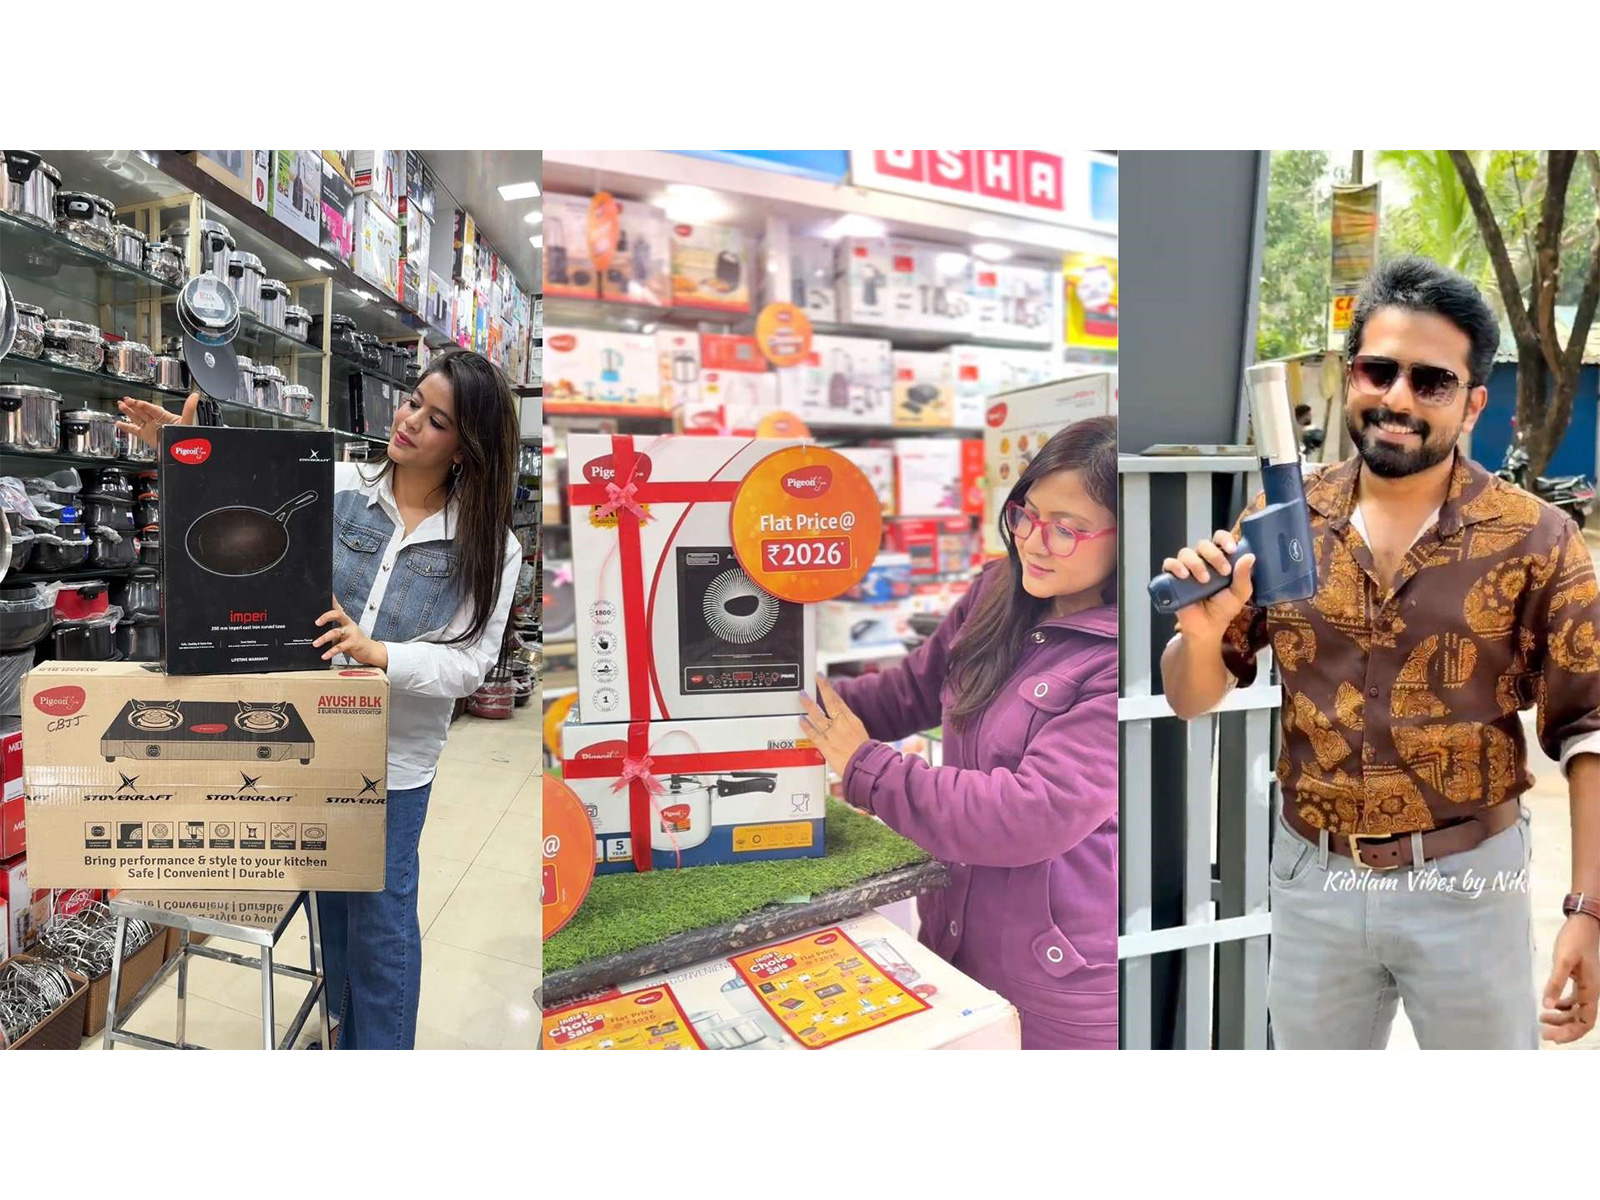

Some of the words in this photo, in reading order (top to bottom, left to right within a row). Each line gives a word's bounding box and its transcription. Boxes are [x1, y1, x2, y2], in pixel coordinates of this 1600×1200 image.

[175, 446, 198, 456] Pigeon
[591, 466, 615, 479] Pige
[787, 477, 816, 488] Pigeon
[760, 514, 793, 531] Flat
[40, 696, 68, 706] Pigeon
[318, 695, 357, 707] AYUSH
[359, 696, 382, 708] BLK
[767, 740, 794, 750] INOX
[205, 794, 294, 802] STOVEKRAFT
[616, 840, 624, 851] 5
[84, 855, 116, 868] Bring
[120, 855, 195, 867] performance
[198, 855, 206, 865] &
[209, 855, 237, 868] style
[240, 856, 252, 866] to
[255, 858, 282, 869] your
[284, 856, 327, 867] kitchen
[128, 868, 154, 878] Safe
[163, 868, 229, 878] Convenient
[239, 869, 285, 879] Durable
[749, 953, 795, 973] Choice
[766, 963, 788, 975] Sale
[548, 1013, 606, 1038] Choice
[567, 1025, 594, 1040] Sale
